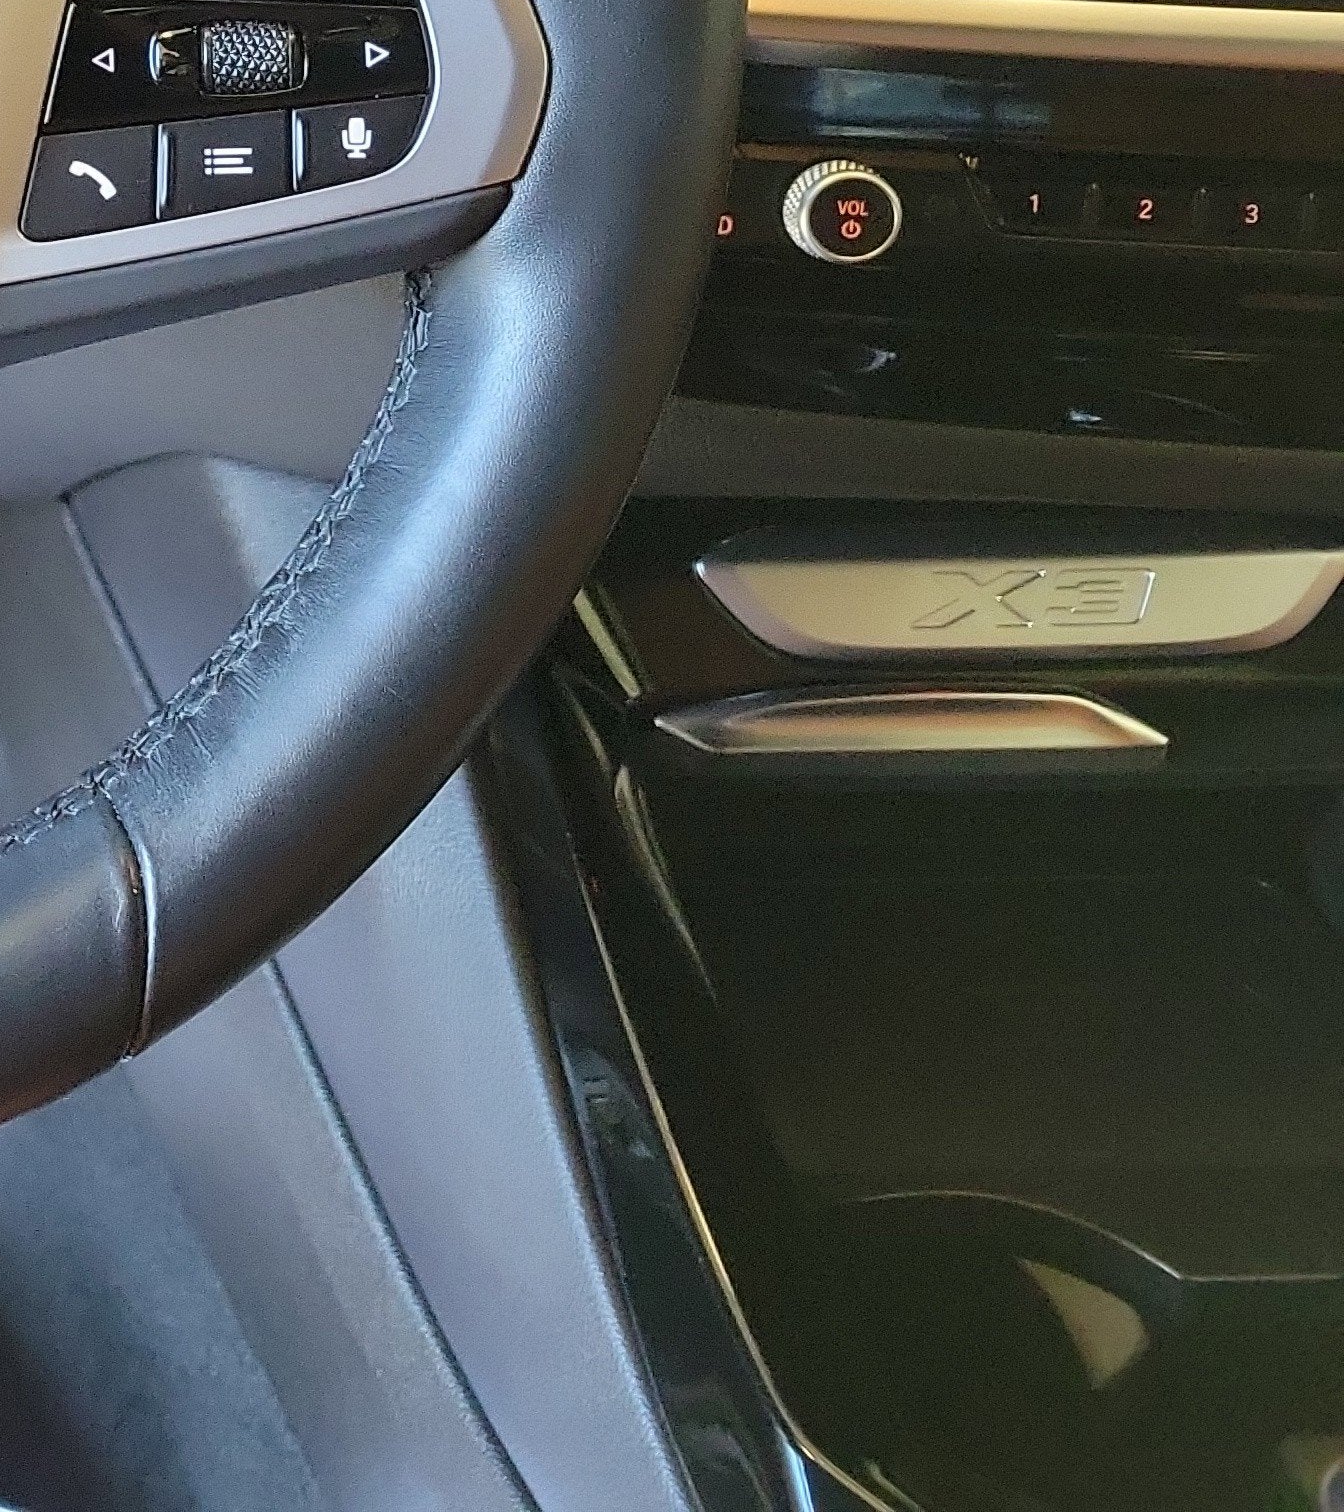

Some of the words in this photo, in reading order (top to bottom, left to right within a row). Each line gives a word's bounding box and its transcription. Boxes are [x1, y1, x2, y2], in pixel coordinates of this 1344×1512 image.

[836, 198, 869, 219] VOL
[1028, 192, 1042, 214] 1
[1138, 199, 1155, 221] 2
[1244, 203, 1260, 225] 3
[913, 567, 1156, 629] X3
